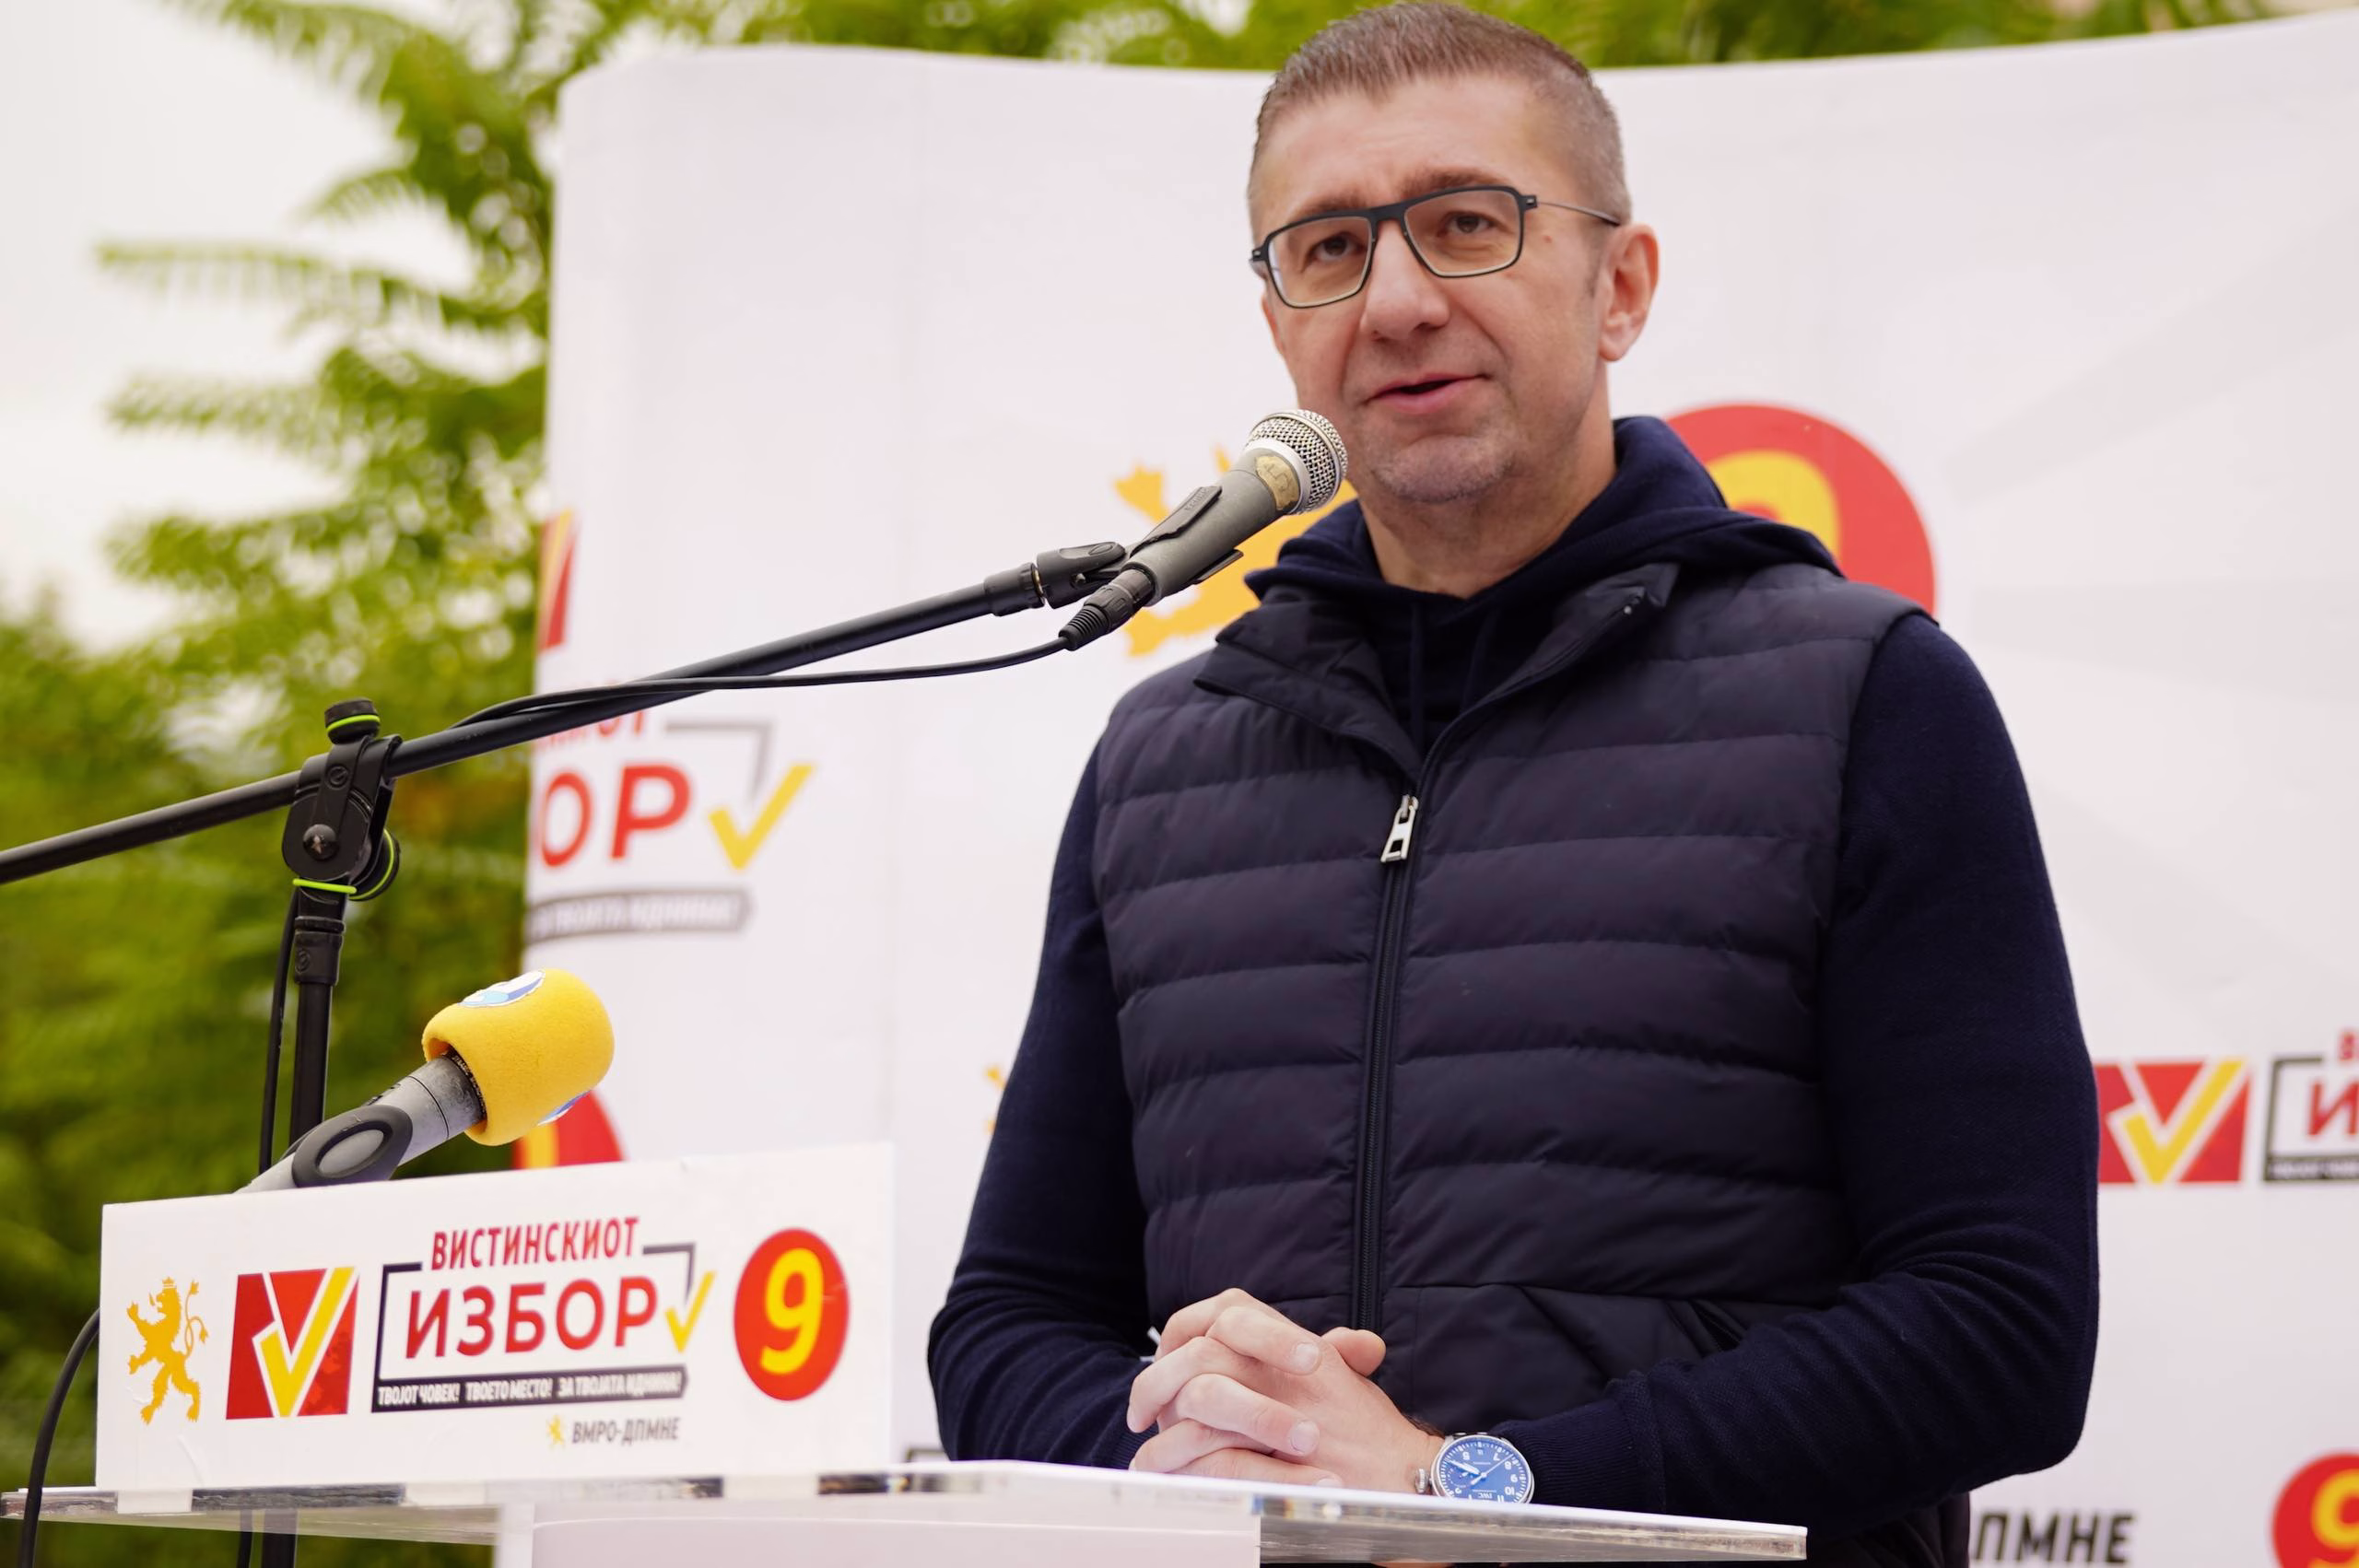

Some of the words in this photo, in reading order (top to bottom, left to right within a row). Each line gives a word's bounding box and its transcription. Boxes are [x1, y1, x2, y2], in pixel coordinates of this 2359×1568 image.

[431, 1216, 640, 1270] ВИСТИНСКИОТ
[405, 1276, 658, 1357] ИЗБОР
[760, 1247, 824, 1374] 9
[572, 1417, 680, 1446] ВМРО-ДПМНЕ
